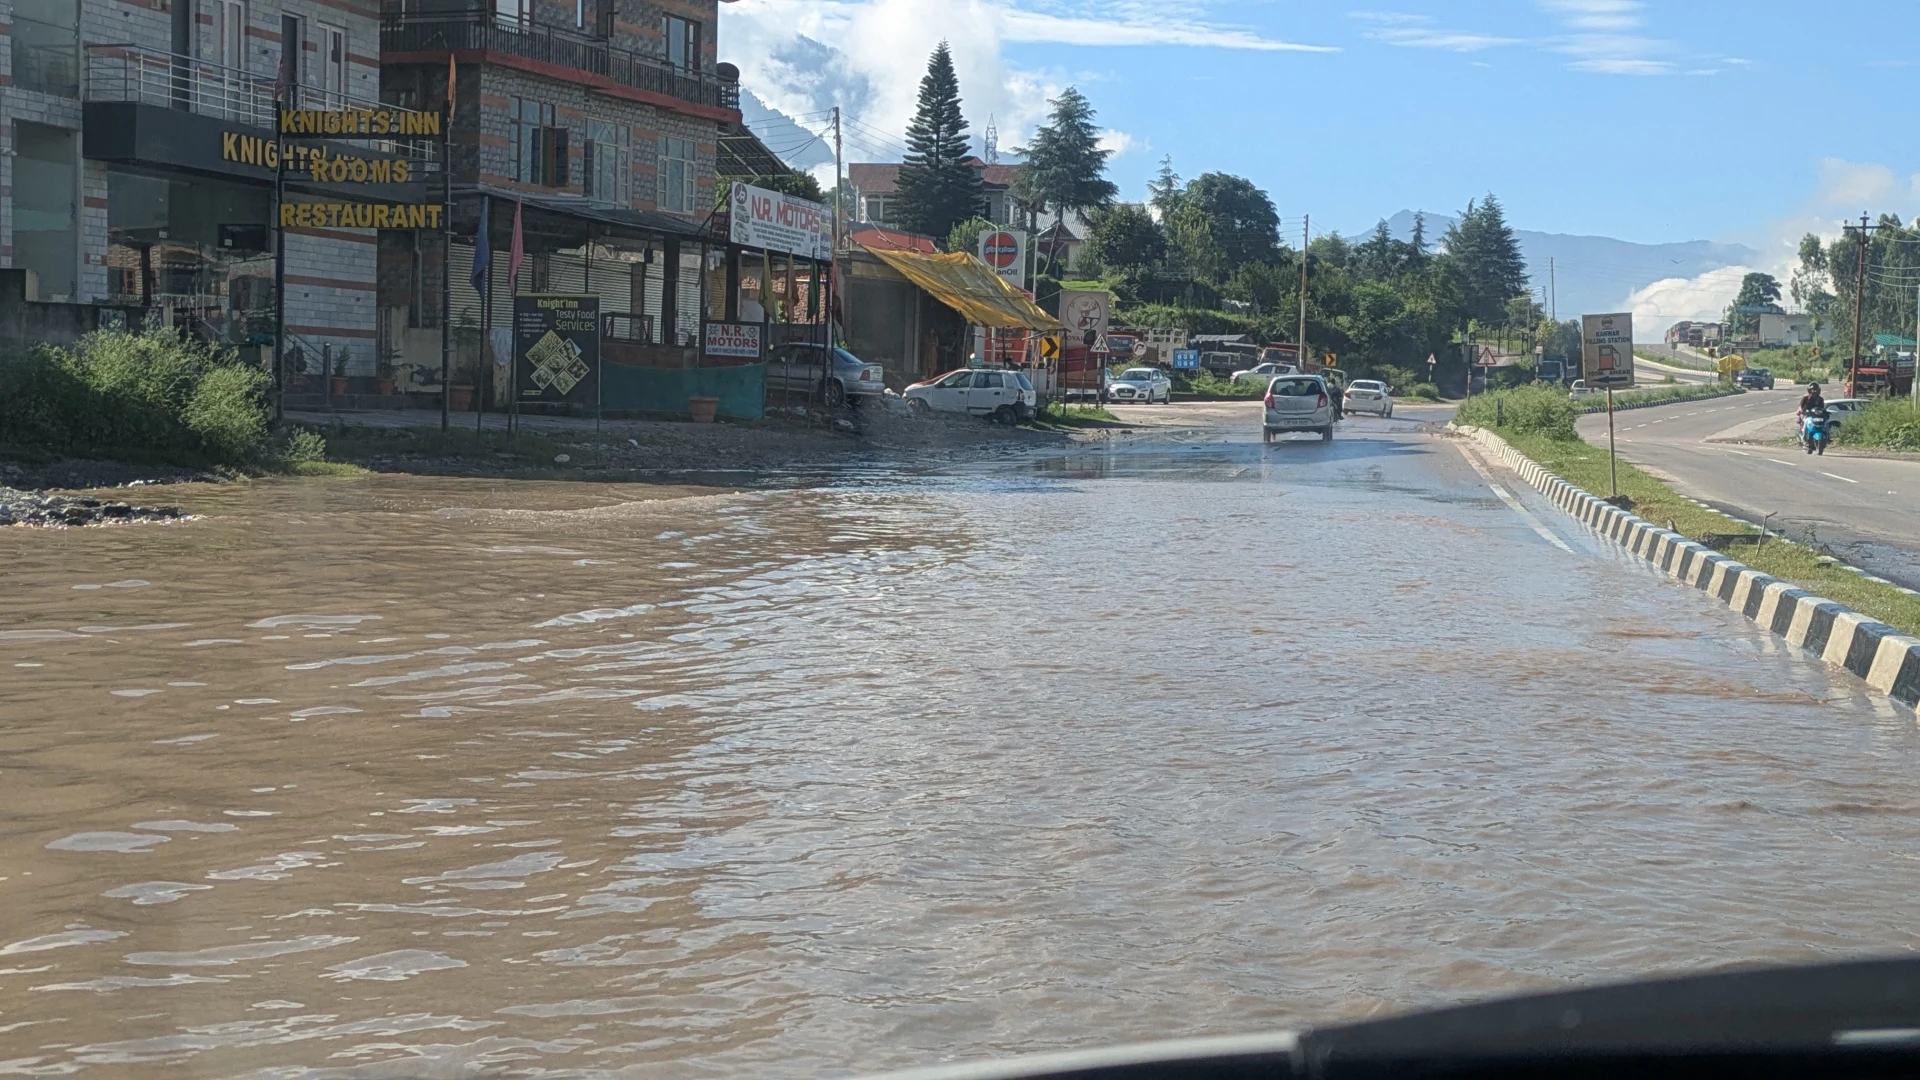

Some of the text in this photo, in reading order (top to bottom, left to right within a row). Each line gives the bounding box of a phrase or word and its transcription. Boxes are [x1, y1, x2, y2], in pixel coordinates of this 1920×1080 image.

[281, 110, 440, 135] KNIGHTS INN
[311, 158, 409, 184] ROOMS
[280, 203, 442, 229] RESTAURANT
[751, 195, 773, 222] N.R.
[776, 201, 820, 233] MOTORS
[577, 310, 595, 319] Food
[556, 320, 596, 331] Services
[721, 325, 745, 337] N.R.
[707, 336, 758, 348] MOTORS
[1585, 336, 1631, 345] FILLING STATION
